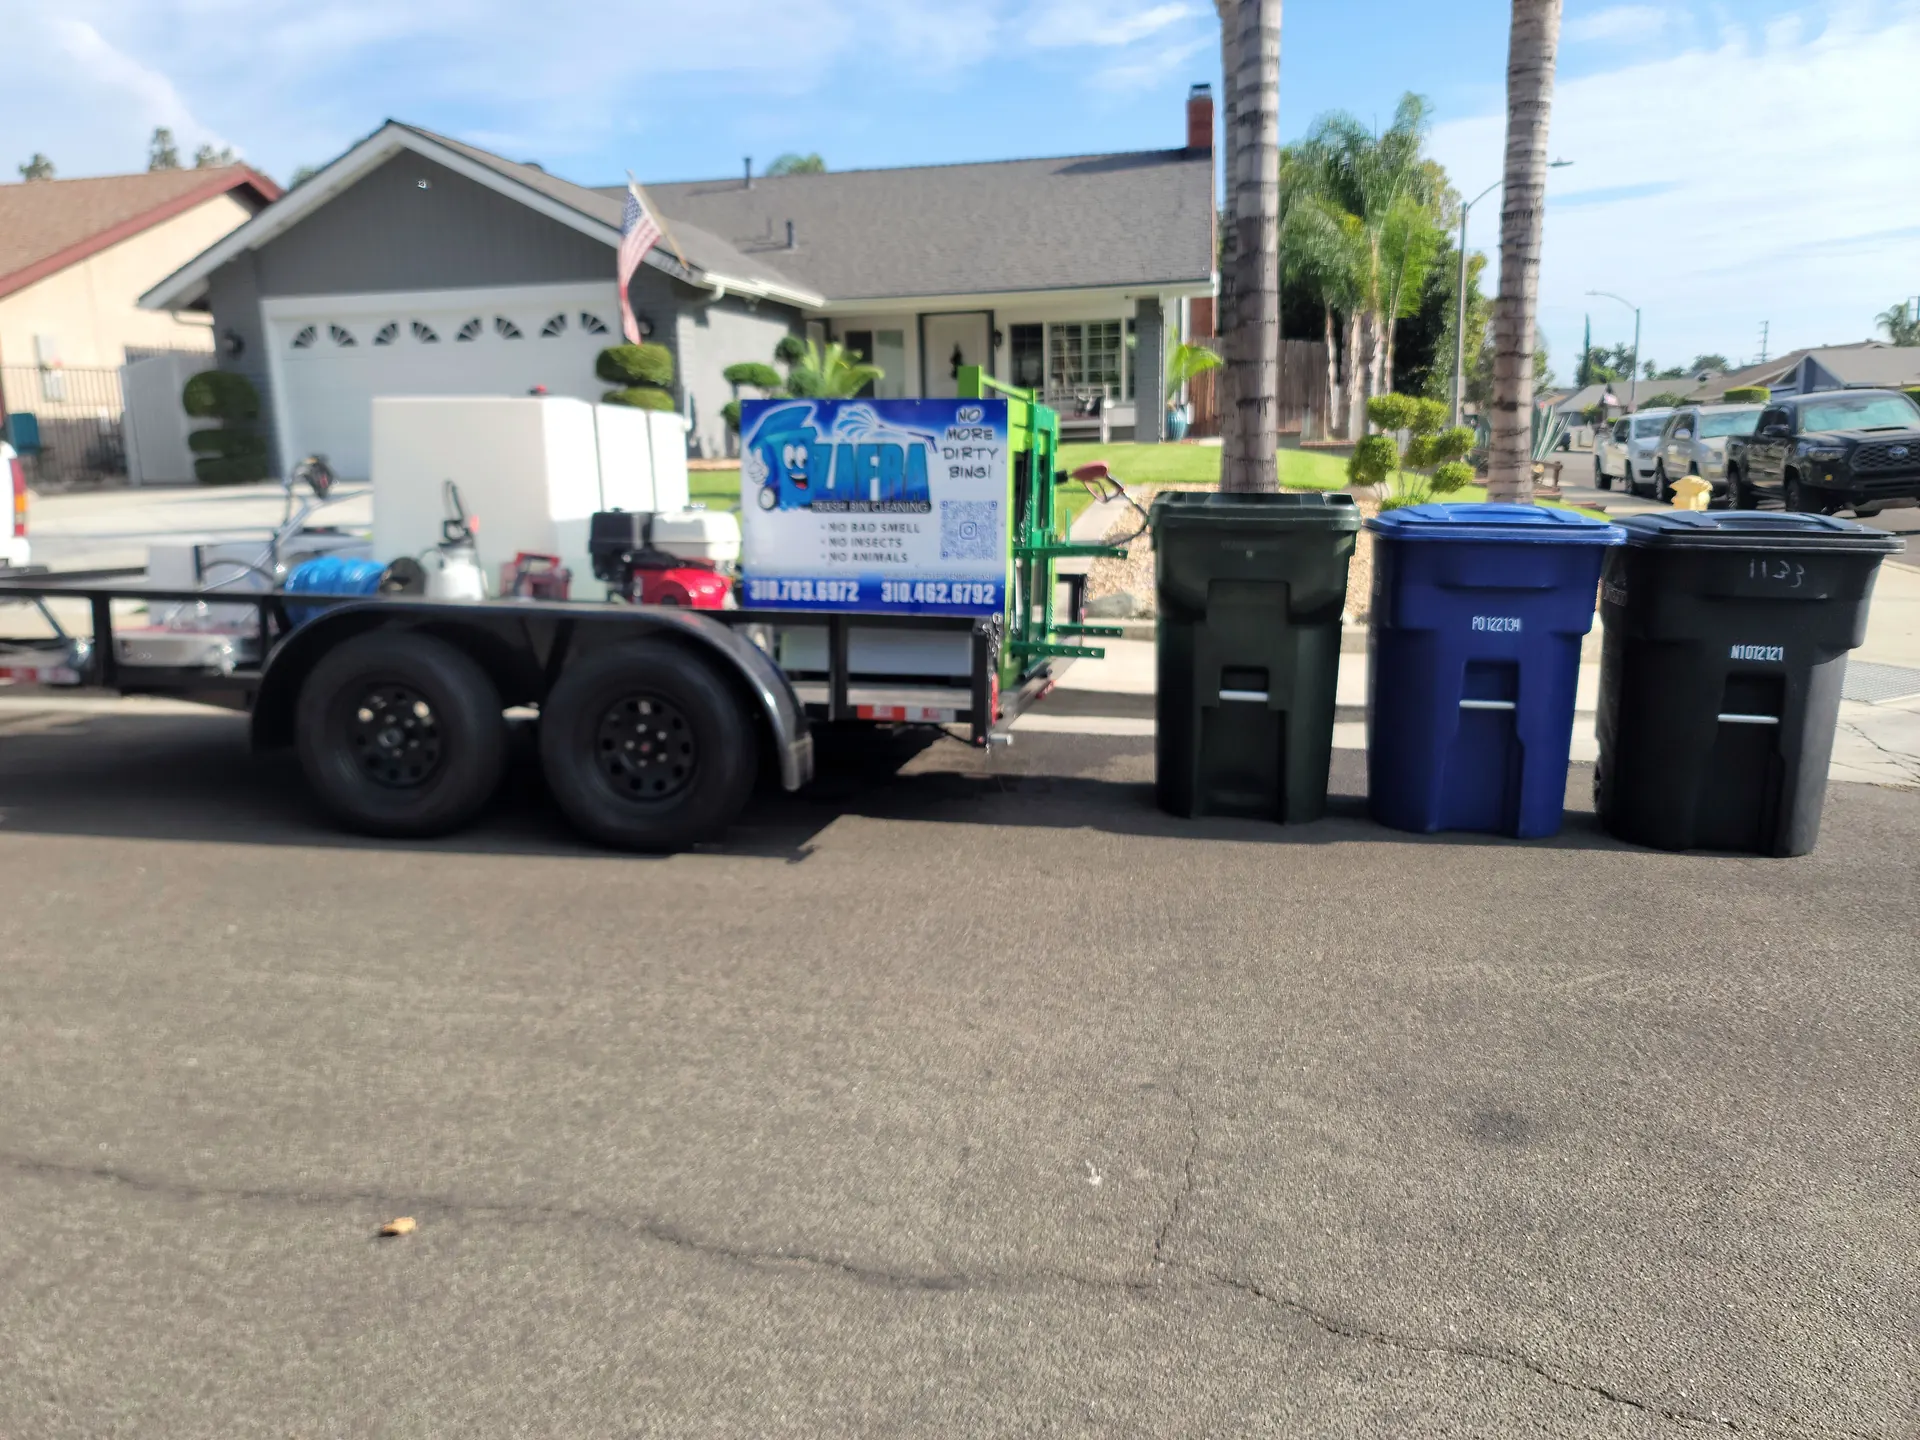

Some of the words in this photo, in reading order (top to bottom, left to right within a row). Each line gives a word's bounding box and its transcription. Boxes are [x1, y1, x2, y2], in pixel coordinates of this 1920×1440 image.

[958, 408, 981, 422] NO
[946, 427, 993, 441] MORE
[943, 446, 999, 460] DIRTY
[949, 464, 991, 479] BINS!
[871, 501, 930, 514] CLEANING
[828, 523, 847, 533] NO
[851, 523, 877, 533] BAD
[881, 523, 920, 534] SMELL
[829, 538, 847, 547] NO
[851, 538, 903, 548] INSECTS
[829, 553, 847, 562] NO
[852, 553, 908, 563] ANIMALS
[881, 582, 996, 605] 310.462.6792
